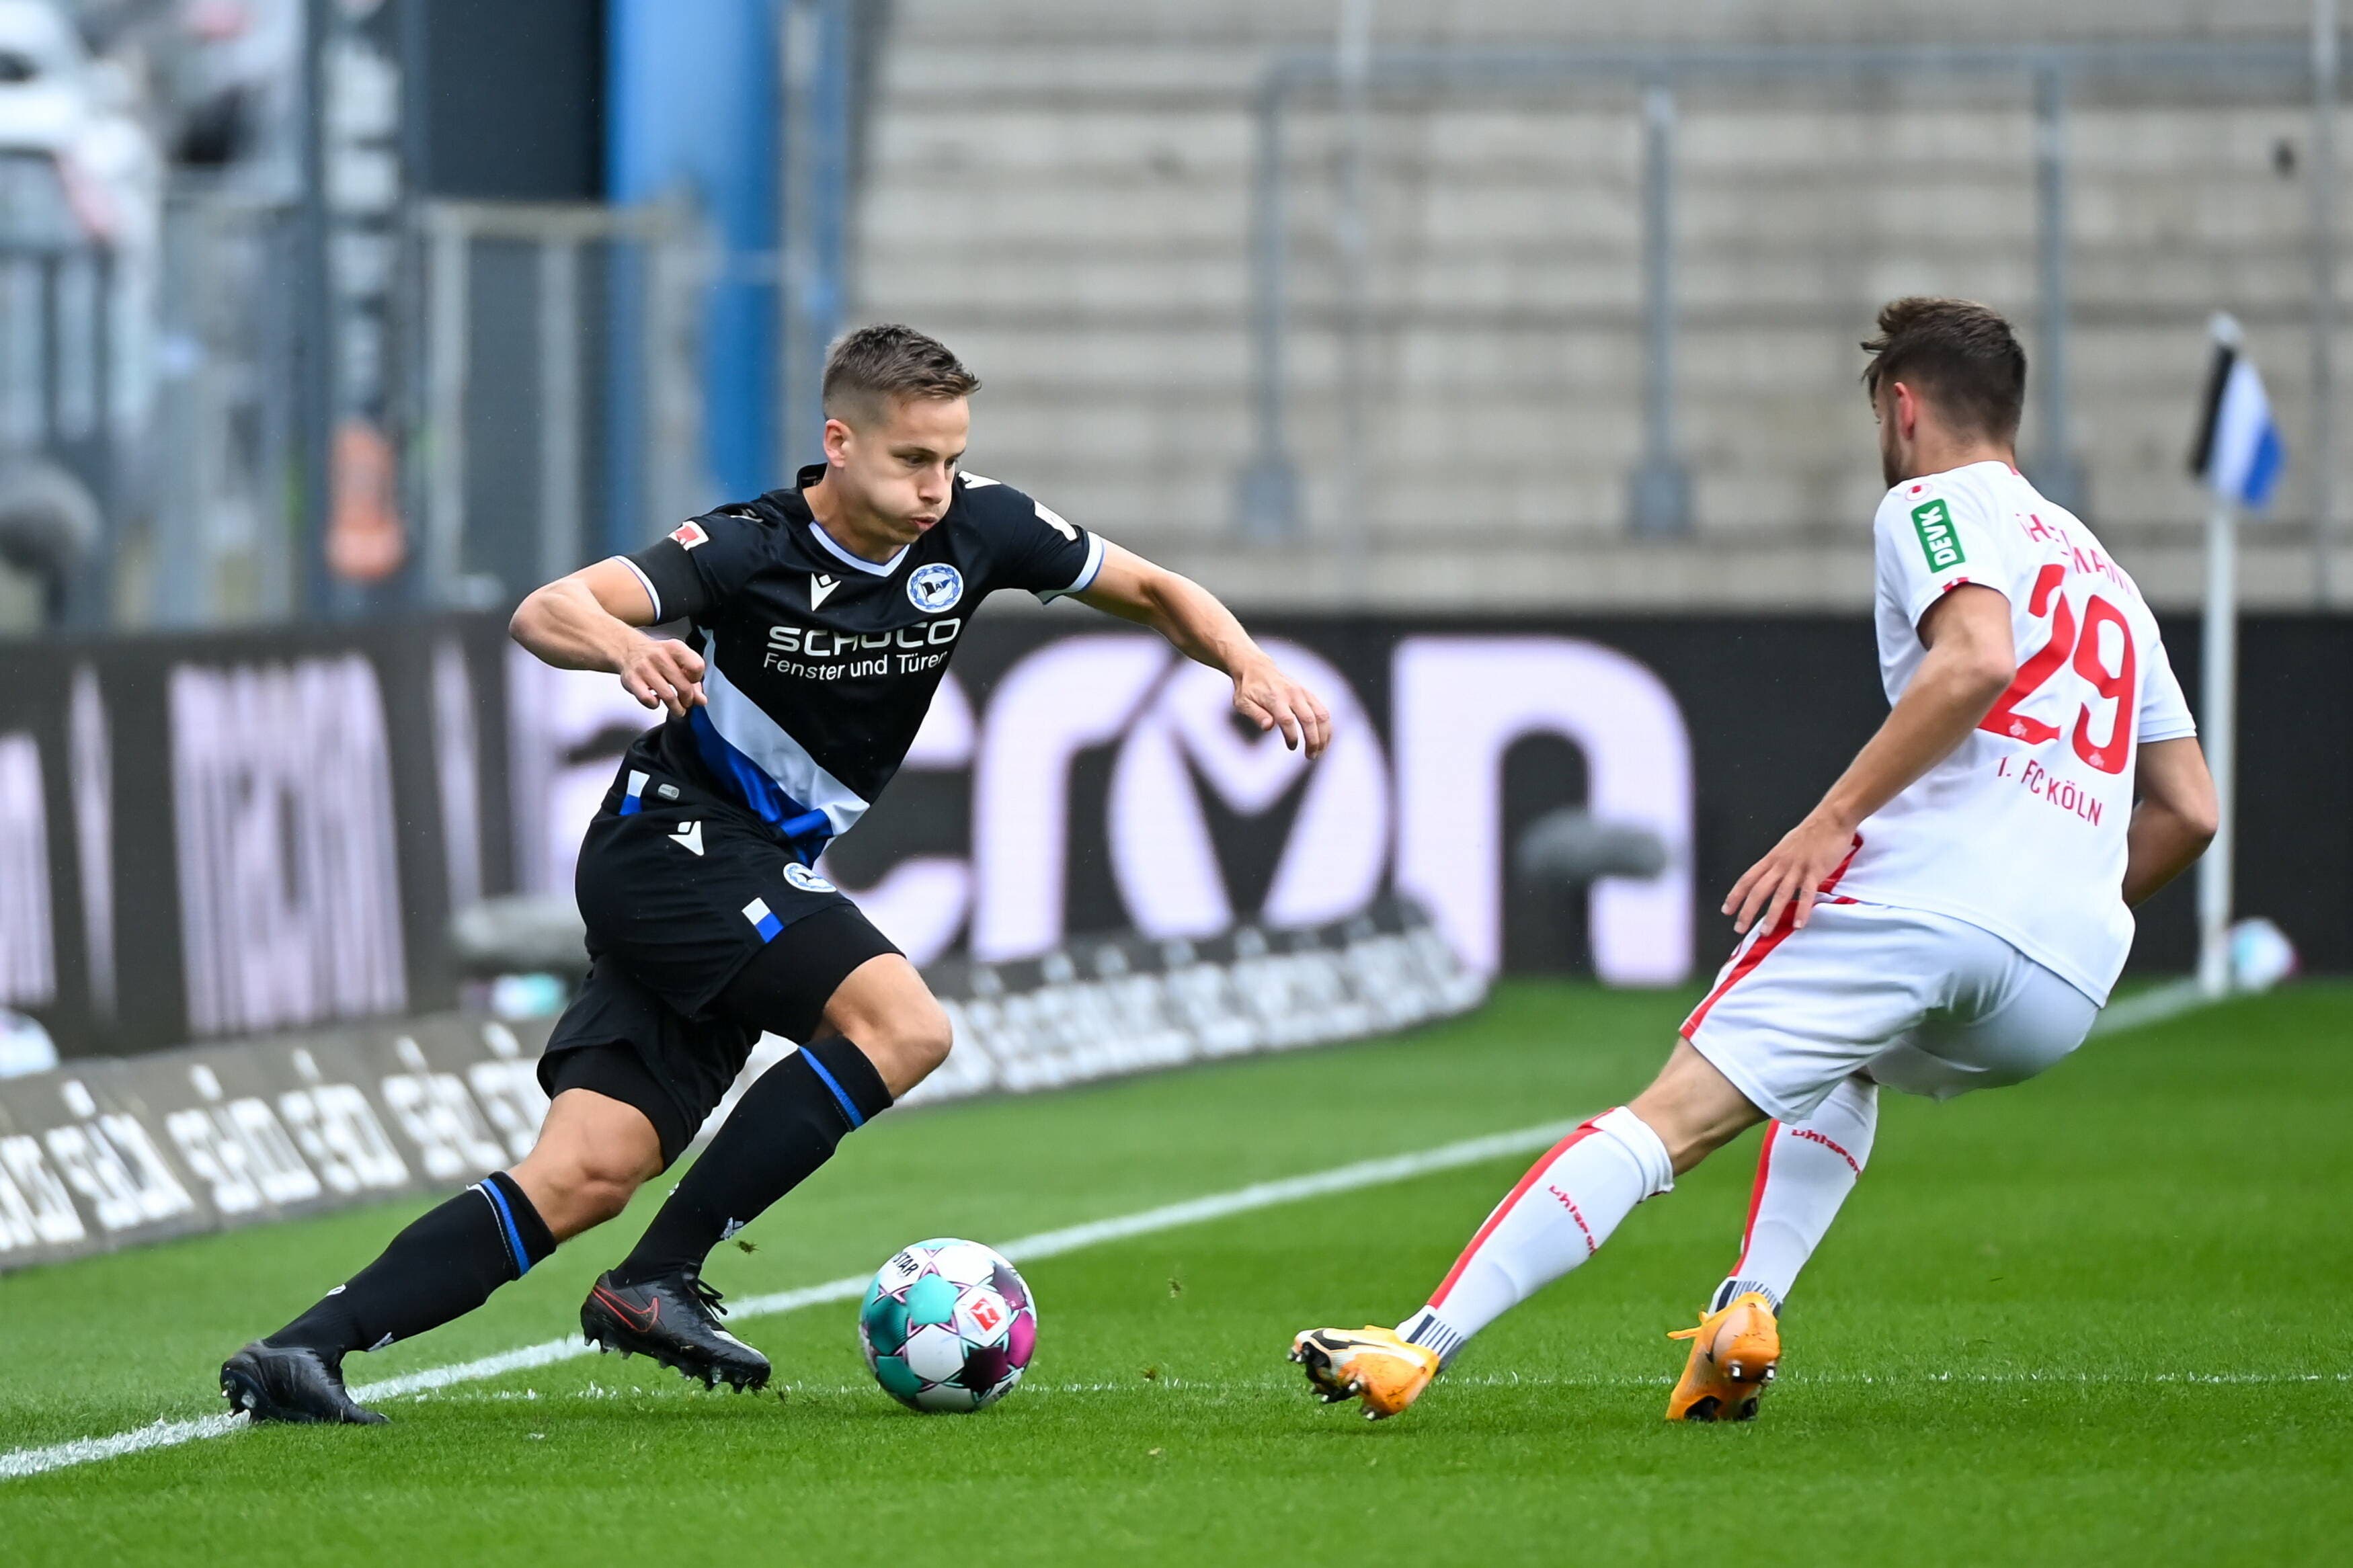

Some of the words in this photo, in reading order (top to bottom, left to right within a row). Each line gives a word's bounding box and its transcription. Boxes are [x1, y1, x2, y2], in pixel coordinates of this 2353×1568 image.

[1918, 505, 1958, 567] DEVK
[763, 652, 846, 681] Fenster
[850, 654, 888, 677] und
[1977, 563, 2137, 775] 29
[2021, 759, 2044, 794] FC
[2046, 777, 2103, 827] KÖLN
